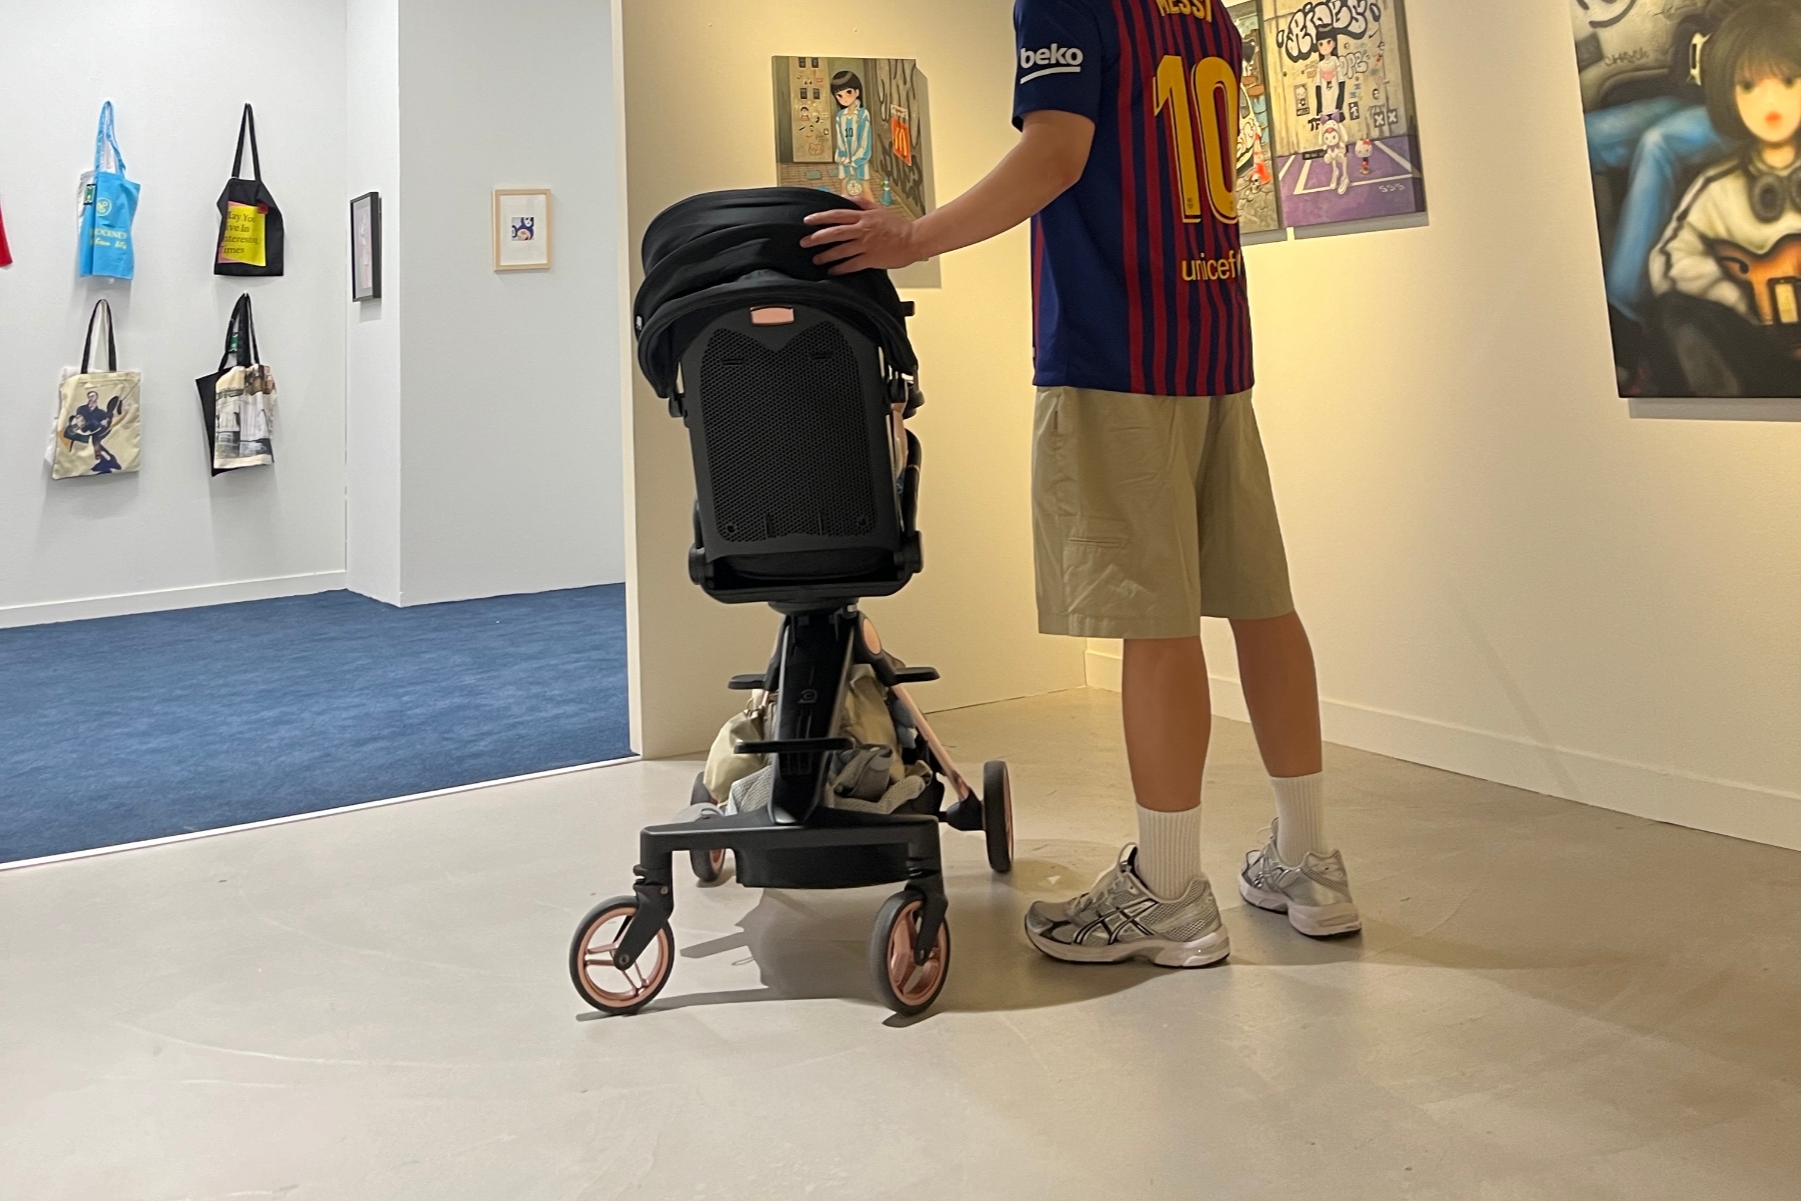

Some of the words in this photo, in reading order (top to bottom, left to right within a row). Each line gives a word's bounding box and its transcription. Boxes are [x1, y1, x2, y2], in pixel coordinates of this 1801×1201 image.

[1020, 43, 1084, 69] beko
[1153, 55, 1240, 224] 10
[1181, 249, 1236, 281] unicef
